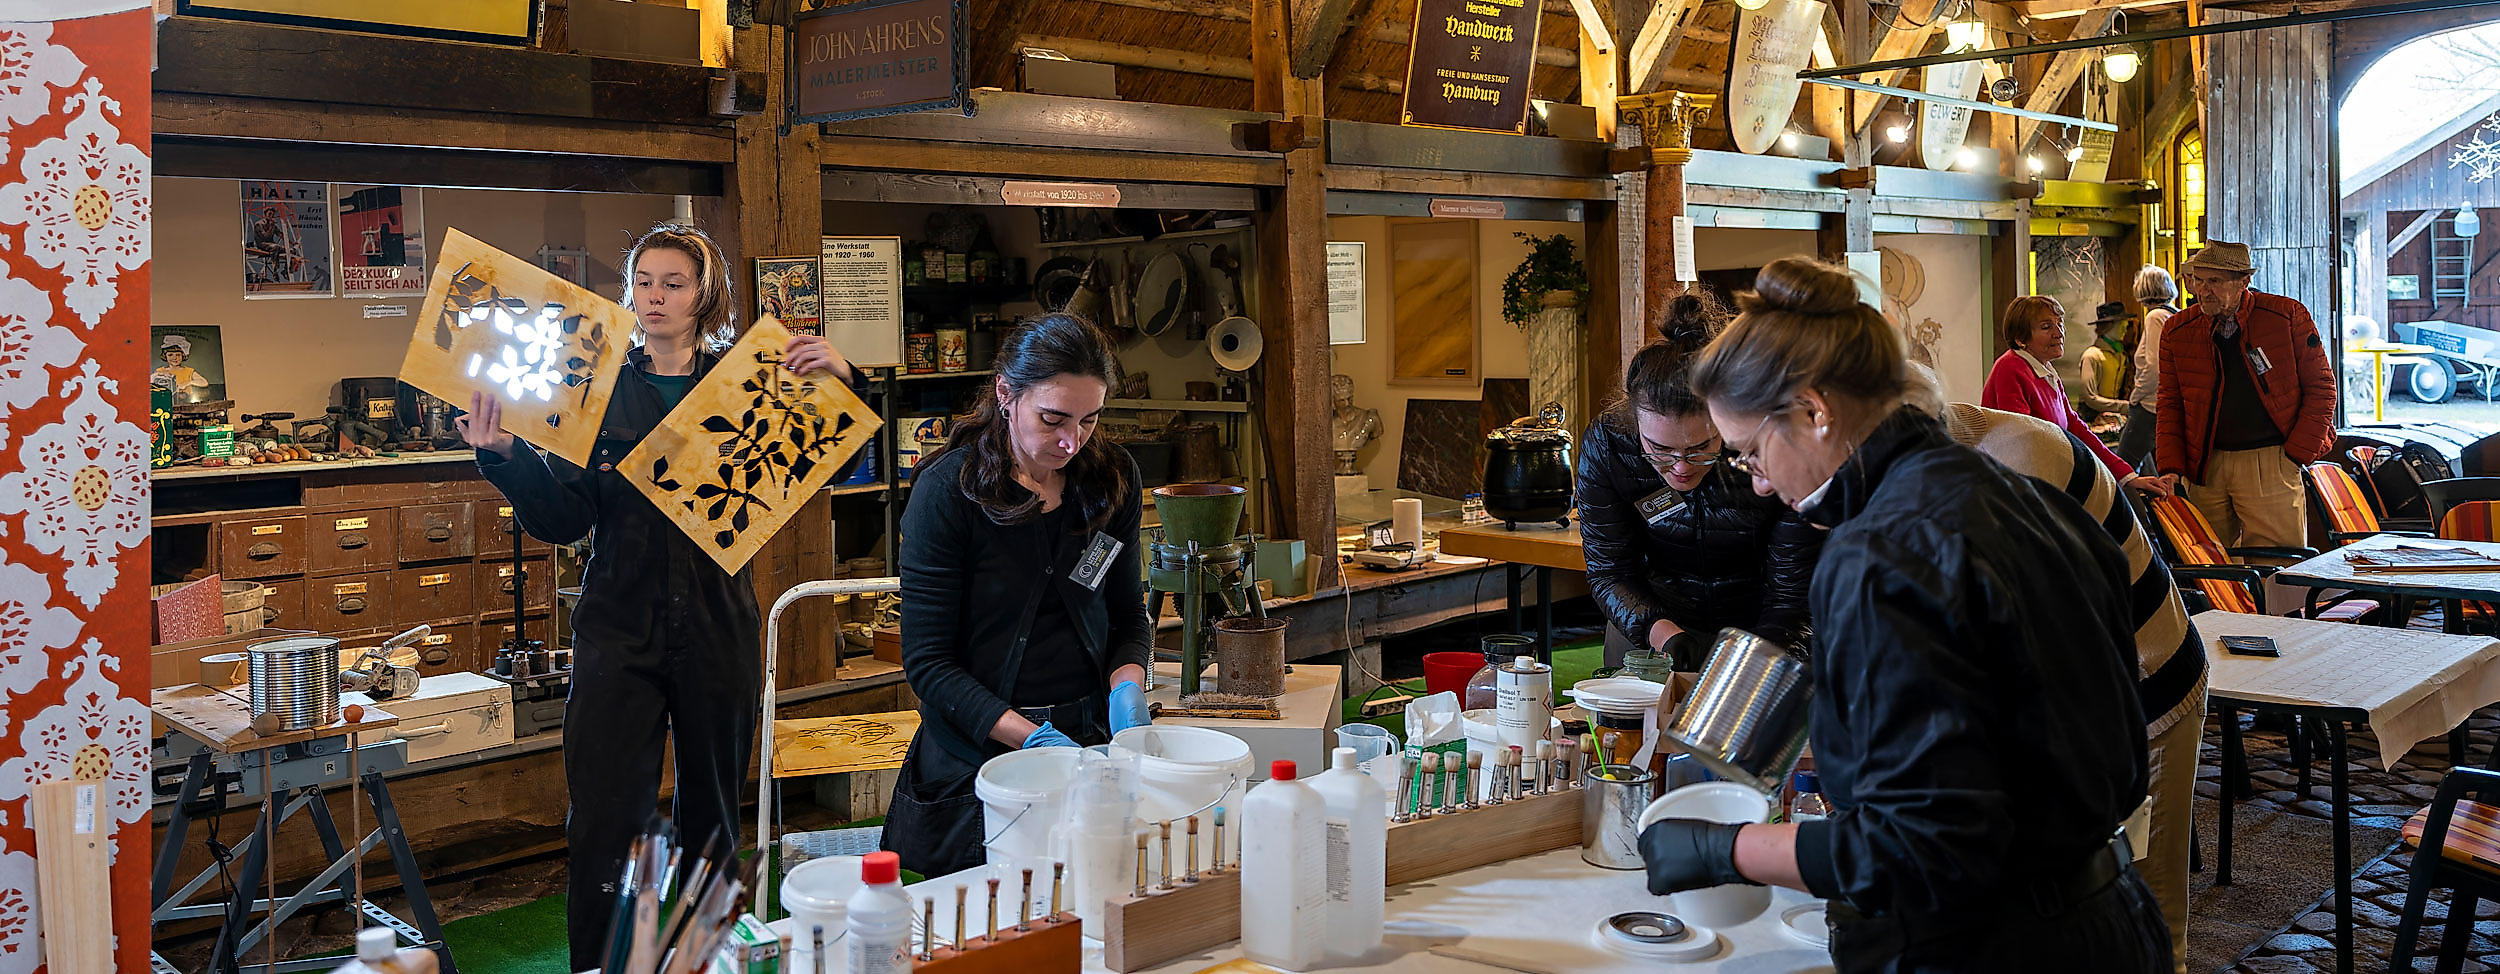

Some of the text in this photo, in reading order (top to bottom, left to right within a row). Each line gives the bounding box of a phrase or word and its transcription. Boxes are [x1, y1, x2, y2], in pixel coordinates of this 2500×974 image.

[1465, 2, 1502, 17] Hersteller
[1445, 14, 1515, 43] Handwerk
[804, 15, 945, 65] JOHN AHRENS
[810, 56, 938, 88] MALERMEISTER
[1436, 68, 1510, 84] FREIE UND HANSESTADT
[1442, 81, 1500, 106] Hamburg
[1047, 191, 1060, 199] von
[1060, 190, 1076, 200] 1920
[835, 251, 851, 259] 1920
[859, 251, 875, 259] 1960
[366, 269, 401, 279] KLUG
[344, 280, 373, 290] SEILT
[375, 280, 399, 290] SICH
[327, 763, 334, 772] R
